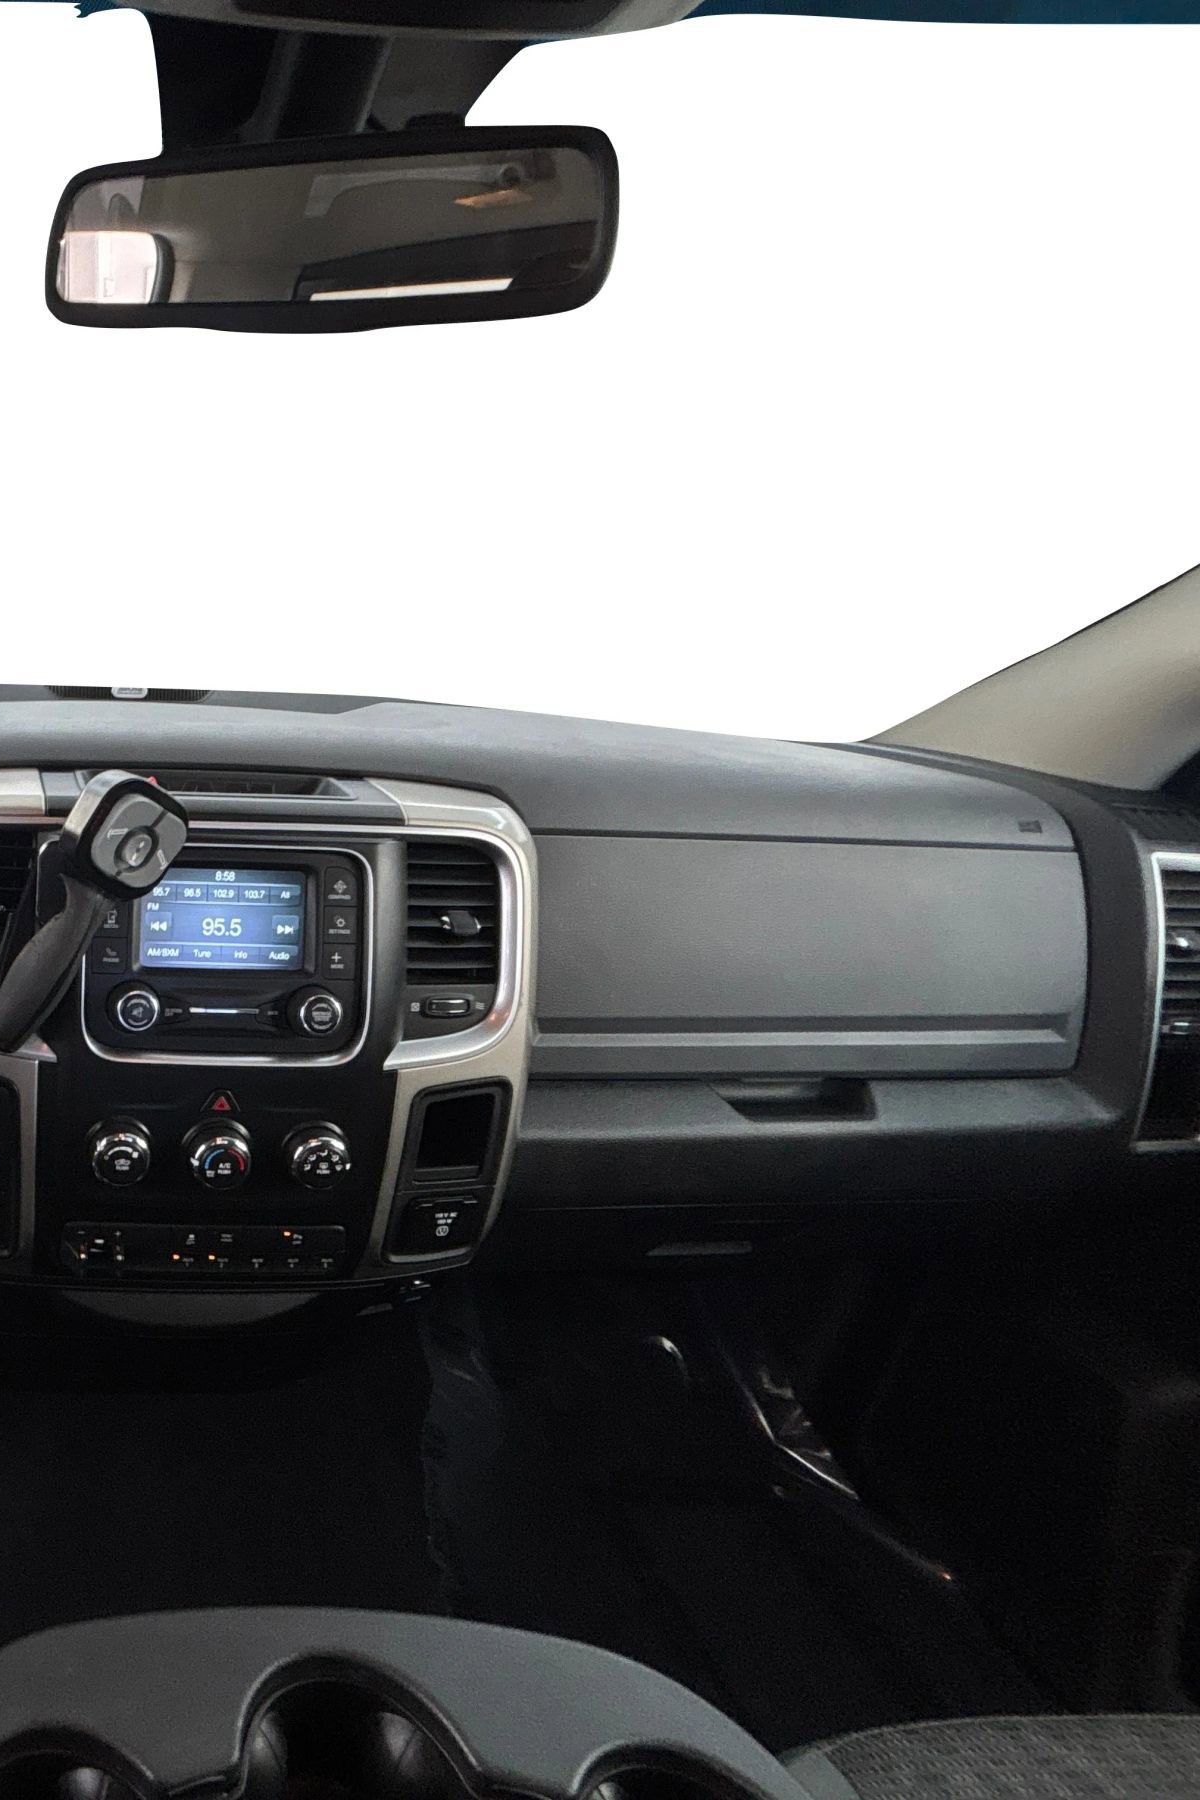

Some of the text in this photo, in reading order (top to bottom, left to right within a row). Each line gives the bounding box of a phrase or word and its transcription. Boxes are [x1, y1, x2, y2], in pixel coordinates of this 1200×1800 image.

[215, 871, 236, 882] 8:58
[152, 887, 171, 897] 95.7
[184, 888, 202, 898] 96.5
[213, 889, 235, 898] 102.9
[244, 890, 266, 899] 103.7
[147, 902, 159, 911] FM
[202, 918, 242, 937] 95.5
[147, 947, 180, 957] AM/SXM
[193, 949, 212, 958] Tune
[234, 950, 248, 959] Info
[268, 951, 290, 960] Audio
